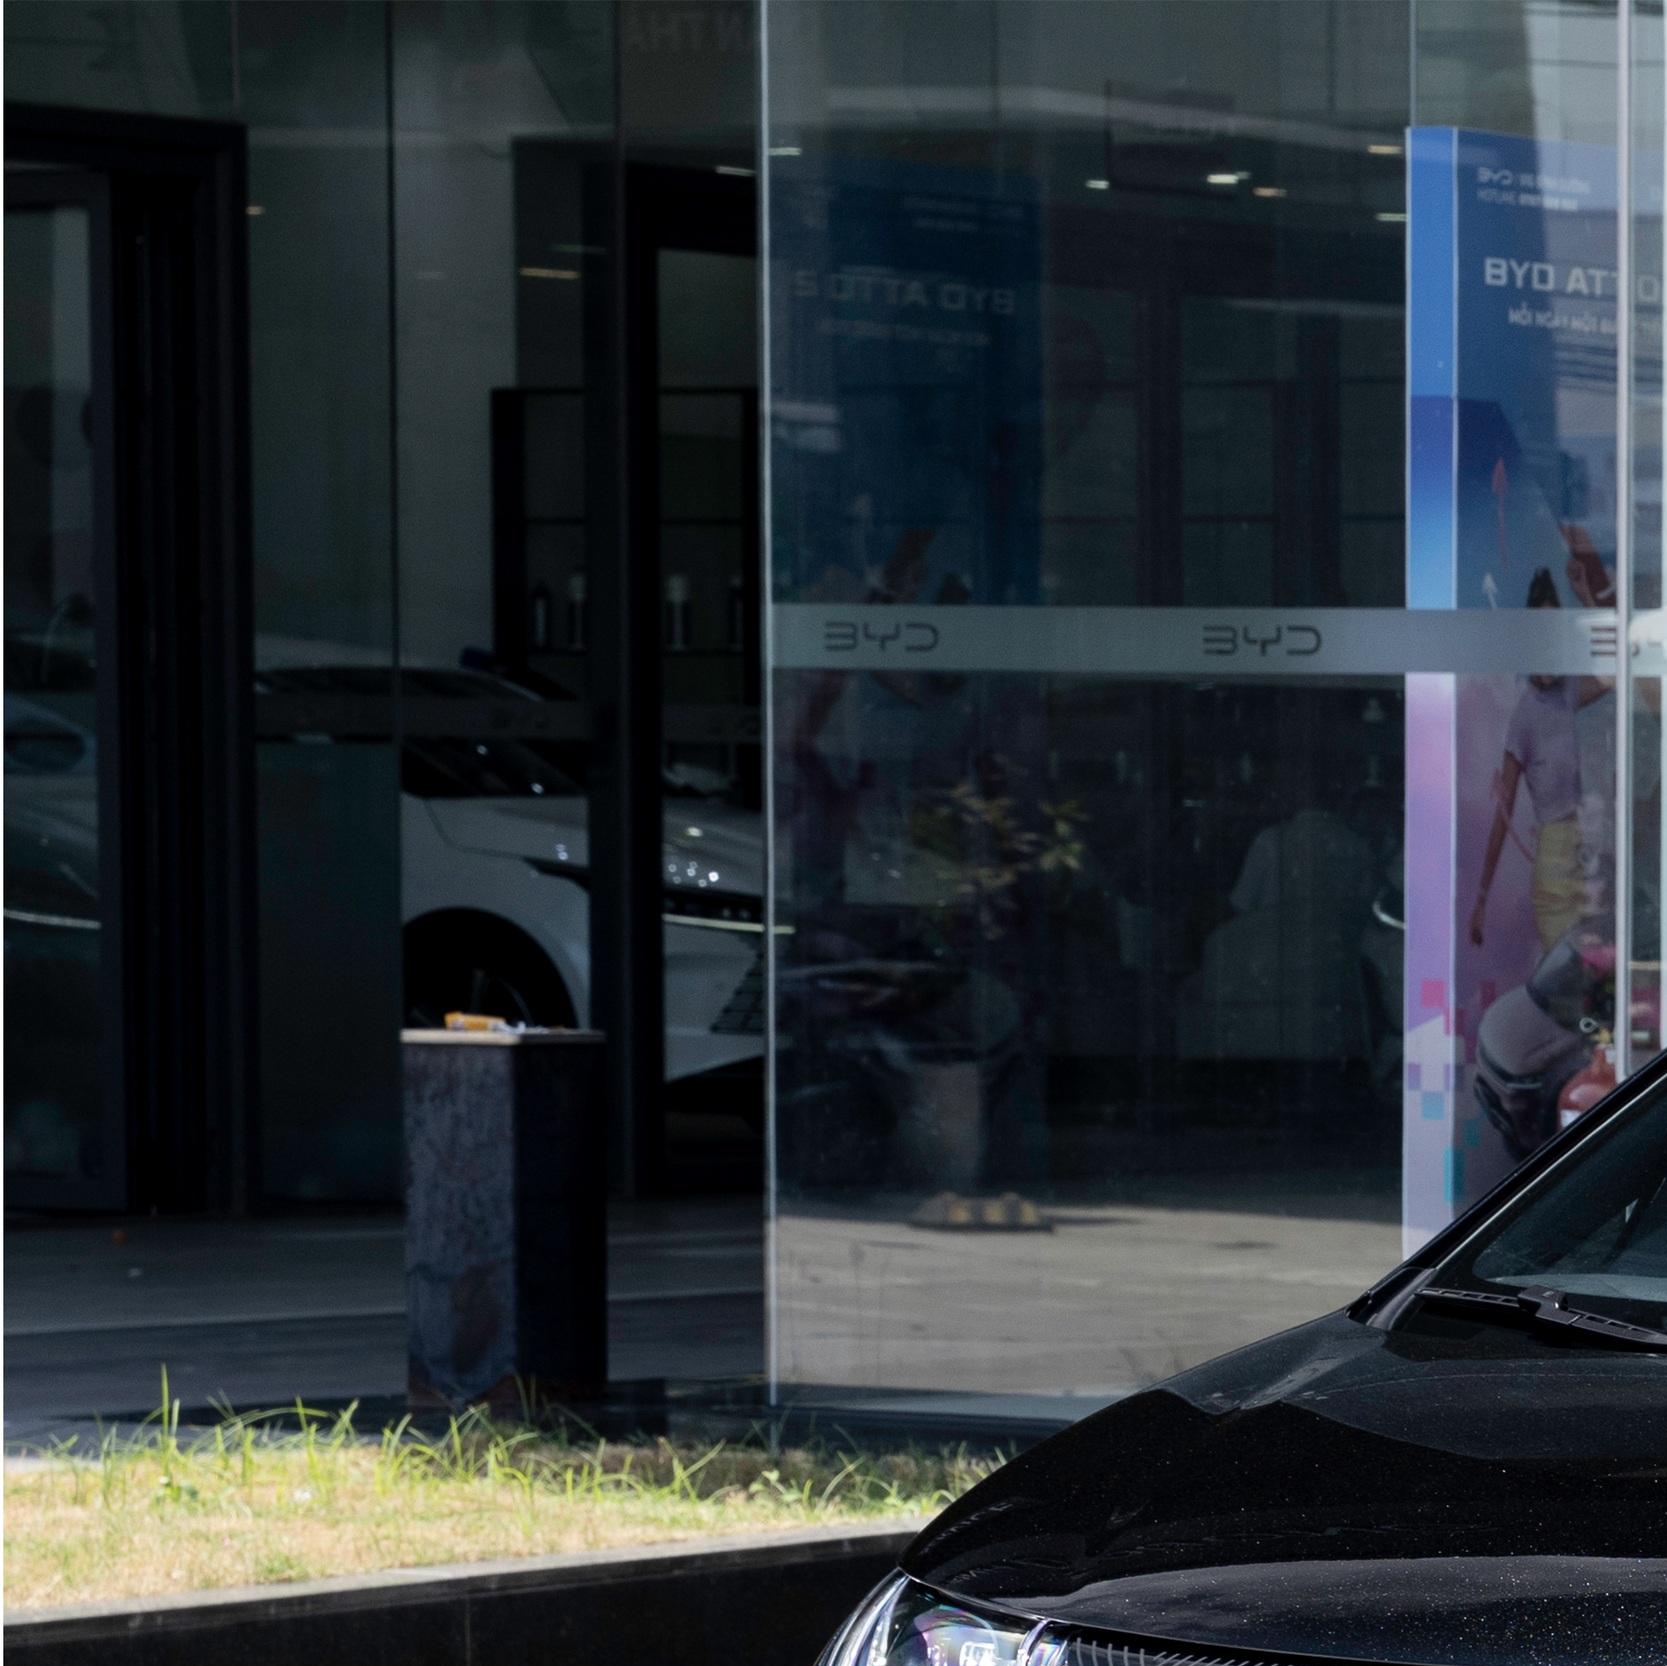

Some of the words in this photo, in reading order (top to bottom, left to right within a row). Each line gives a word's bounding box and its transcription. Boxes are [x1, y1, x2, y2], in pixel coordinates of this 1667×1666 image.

[1483, 257, 1556, 292] BYD
[1566, 266, 1660, 303] ATO
[825, 622, 939, 653] BYD
[1203, 625, 1323, 656] BYD
